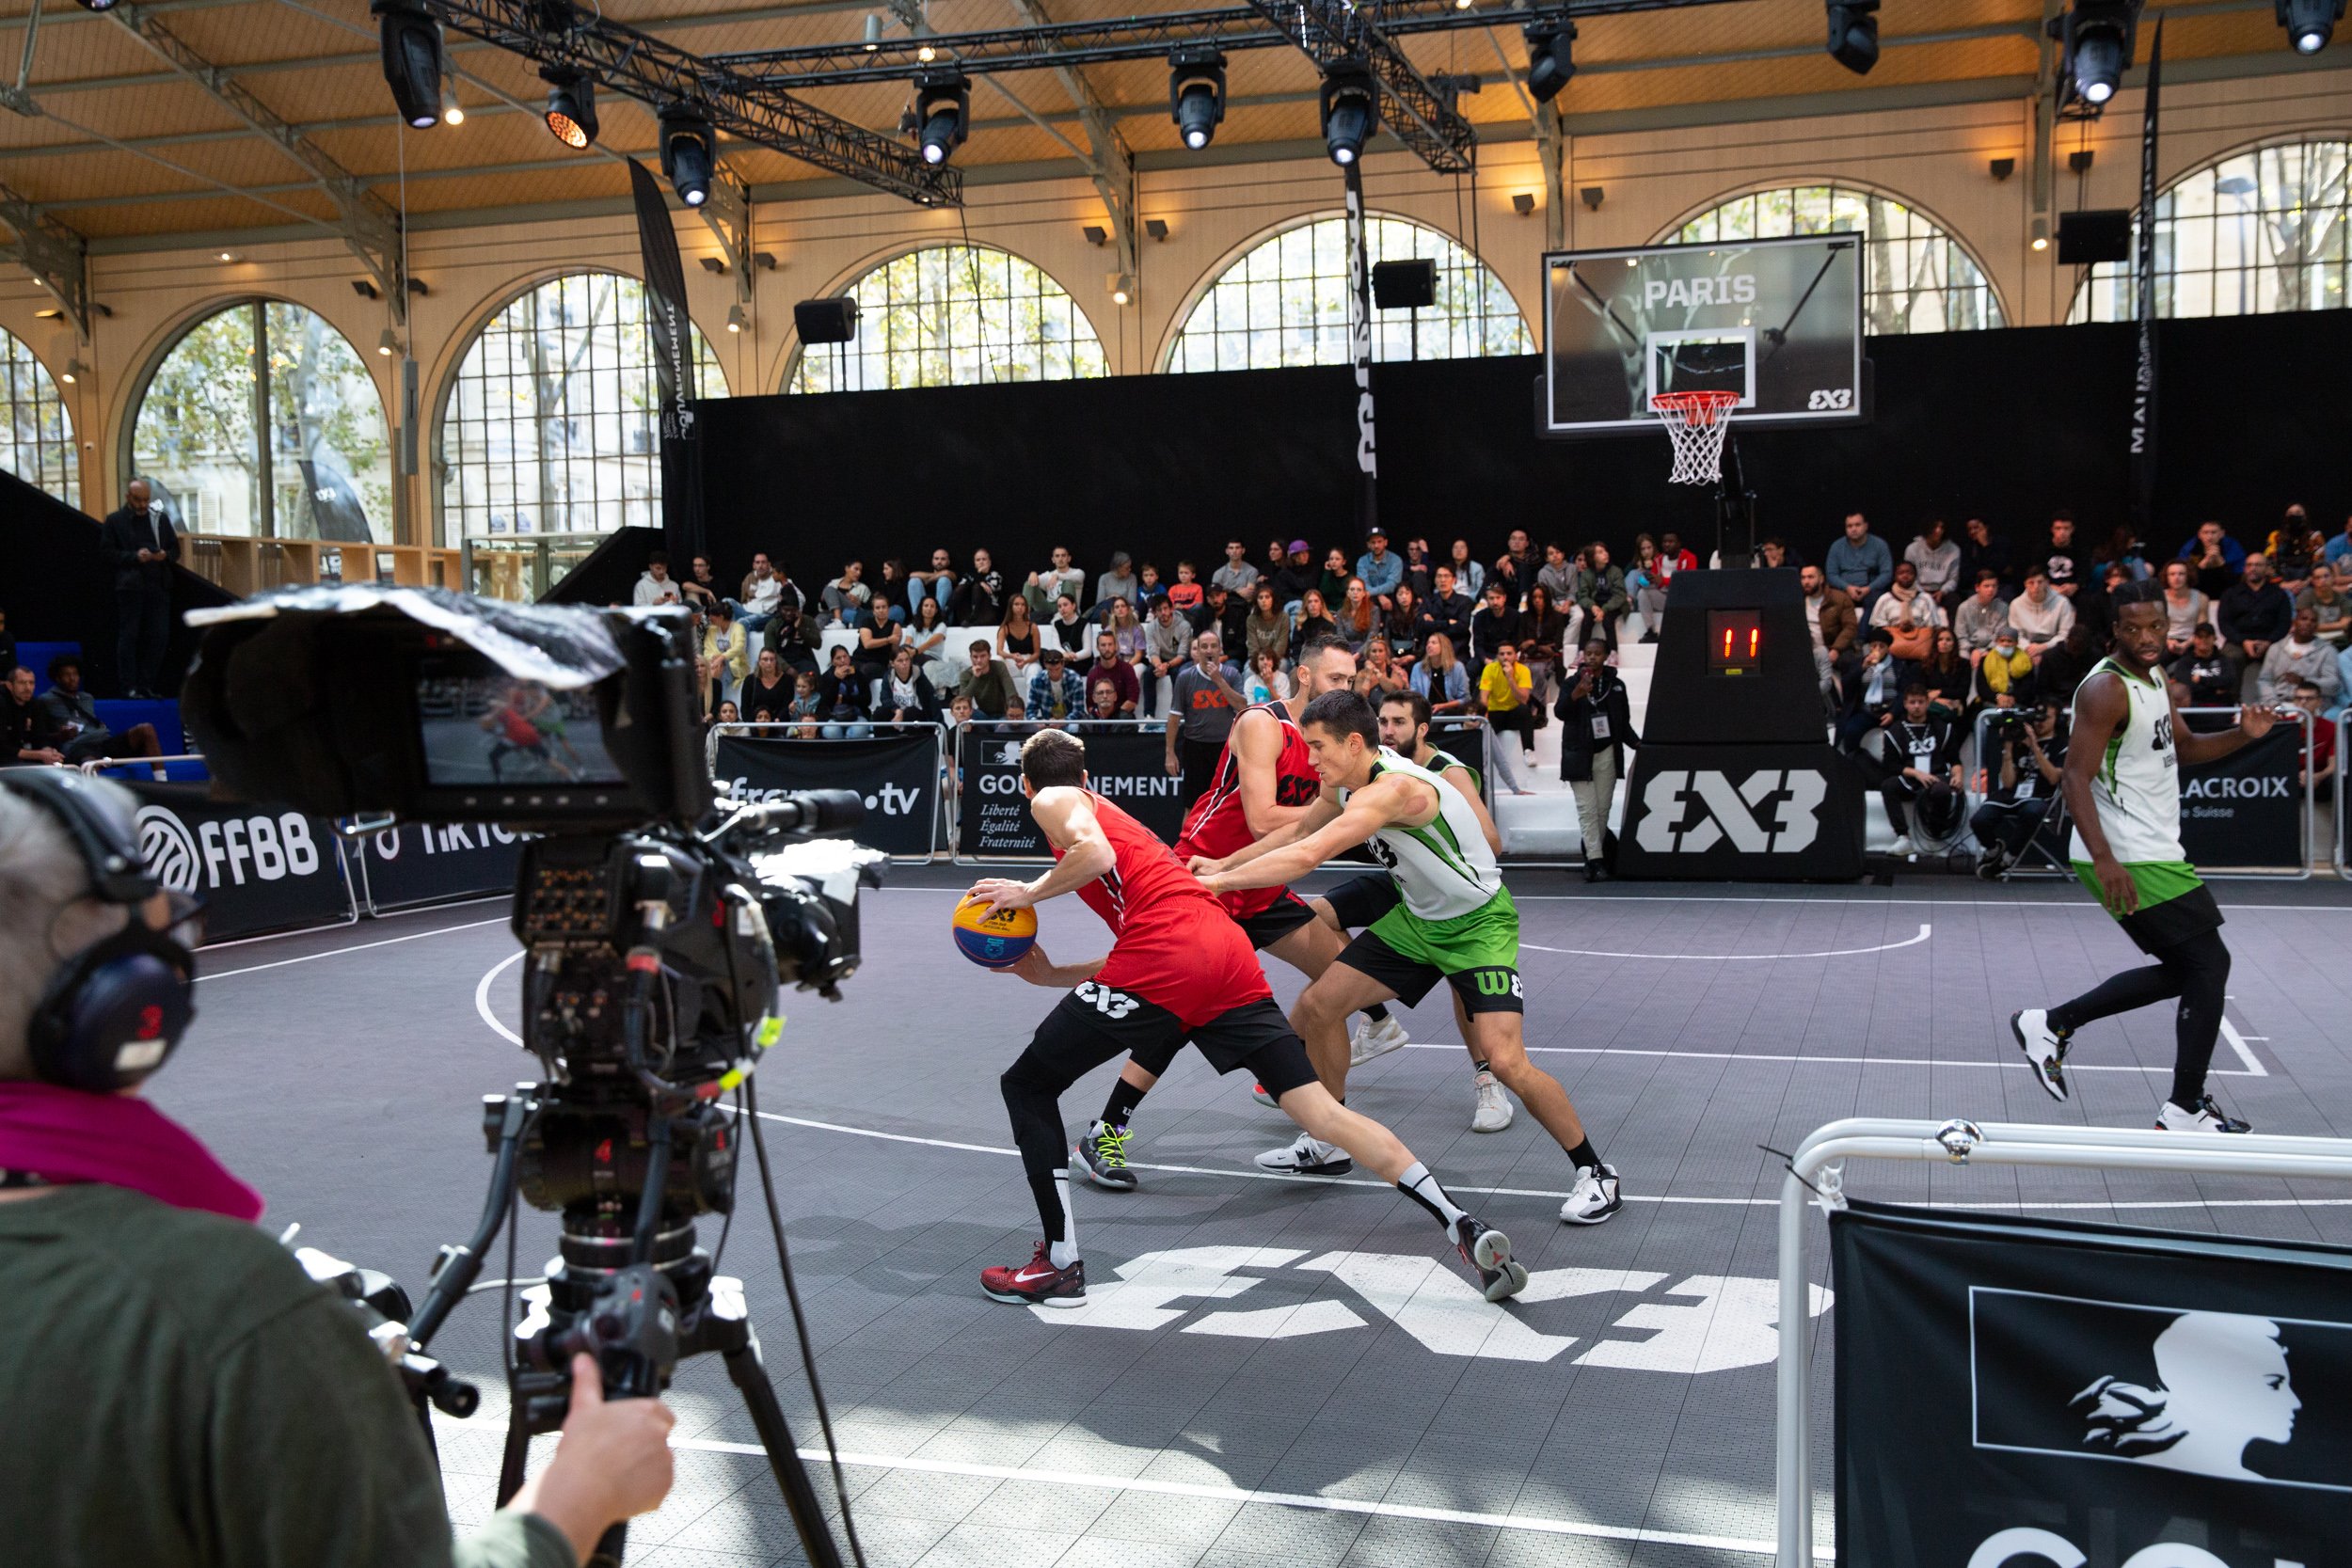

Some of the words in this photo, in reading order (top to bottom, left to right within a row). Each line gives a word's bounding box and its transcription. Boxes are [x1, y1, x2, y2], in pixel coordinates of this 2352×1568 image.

[1644, 275, 1756, 309] PARIS
[1724, 628, 1760, 658] 11
[978, 774, 1184, 798] GOUNEMENT
[2179, 777, 2290, 799] ACROIX
[980, 804, 1021, 816] Liberté
[2192, 806, 2234, 818] Suisse
[979, 817, 1021, 833] Égalité
[199, 812, 319, 888] FFBB
[979, 836, 1037, 848] Fraternité
